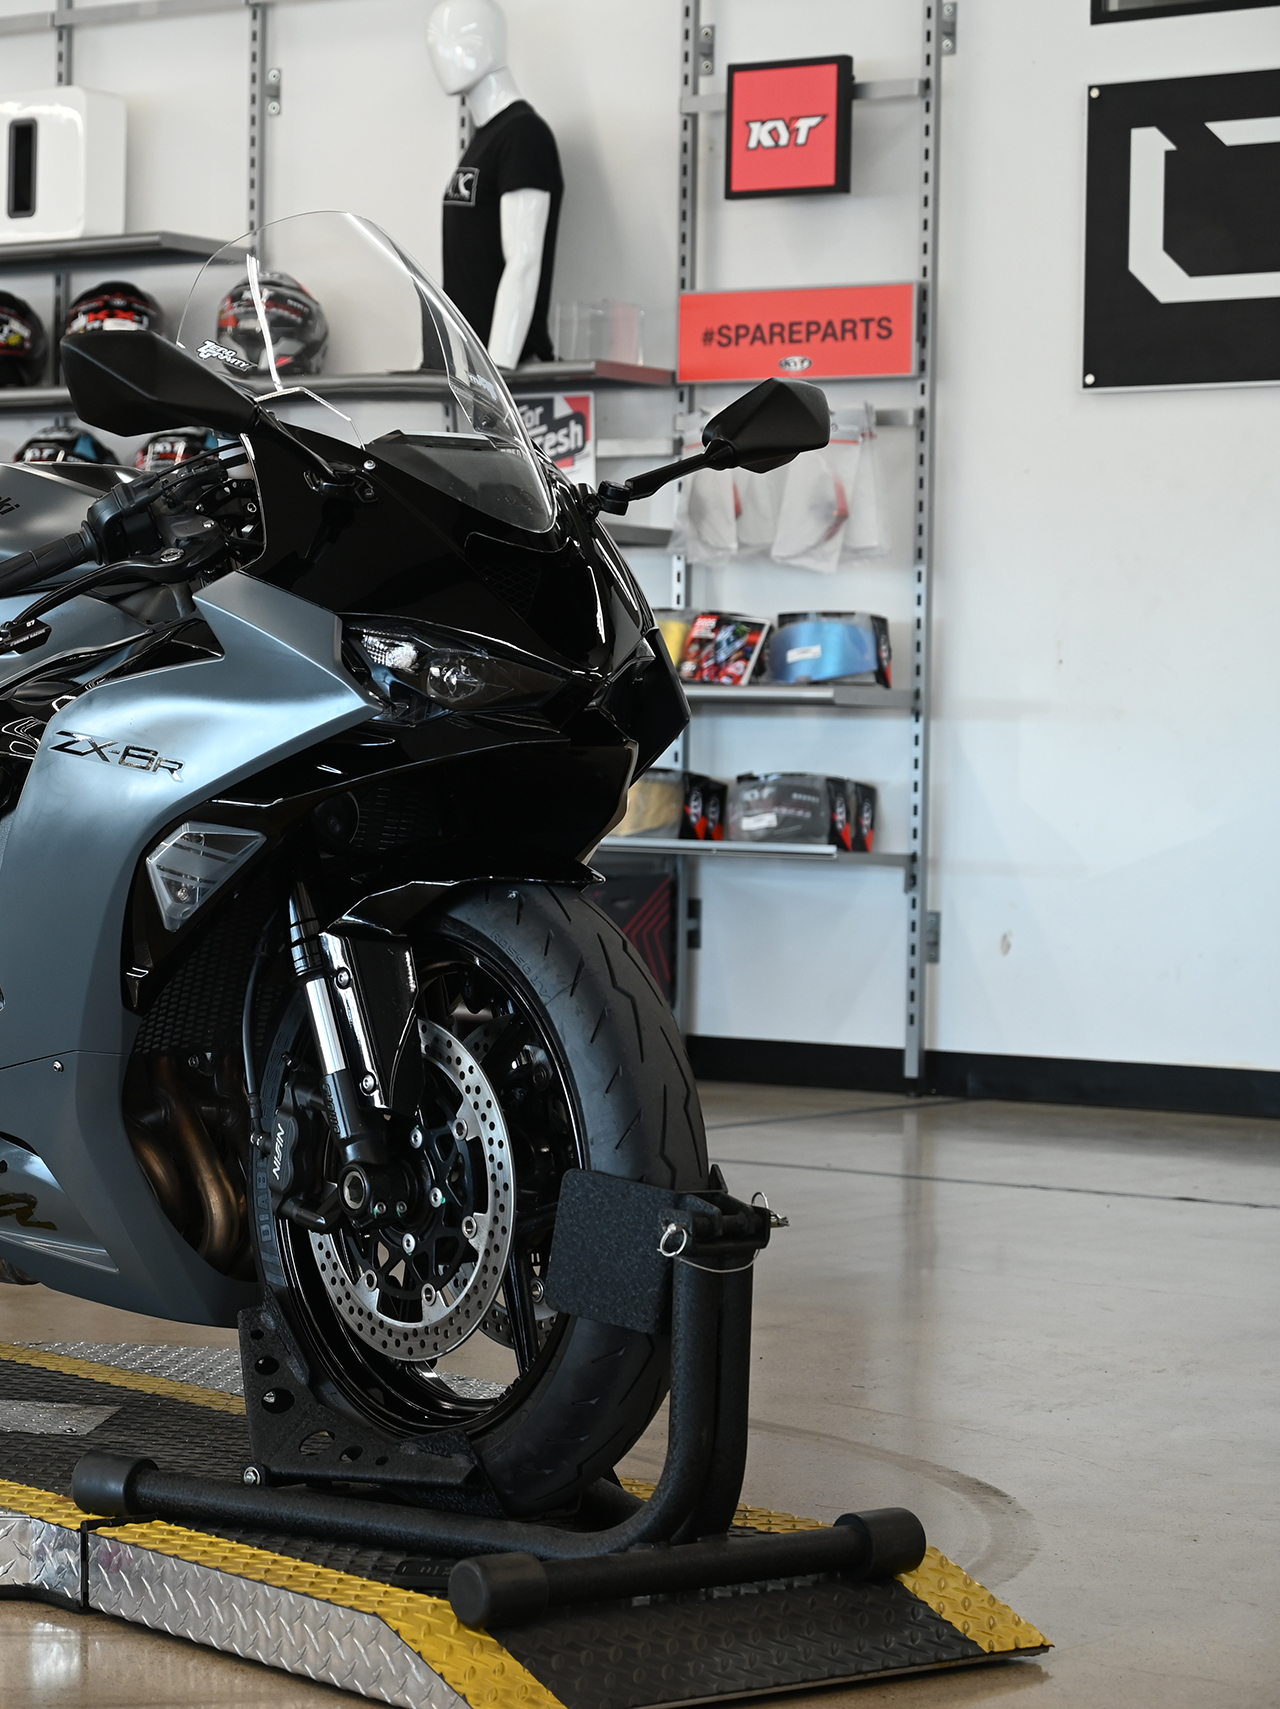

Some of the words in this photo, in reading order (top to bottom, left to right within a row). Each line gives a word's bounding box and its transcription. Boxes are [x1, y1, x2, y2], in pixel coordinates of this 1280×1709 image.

[746, 115, 827, 151] KYT
[702, 316, 893, 347] #SPAREPARTS
[49, 730, 184, 781] ZX-6R
